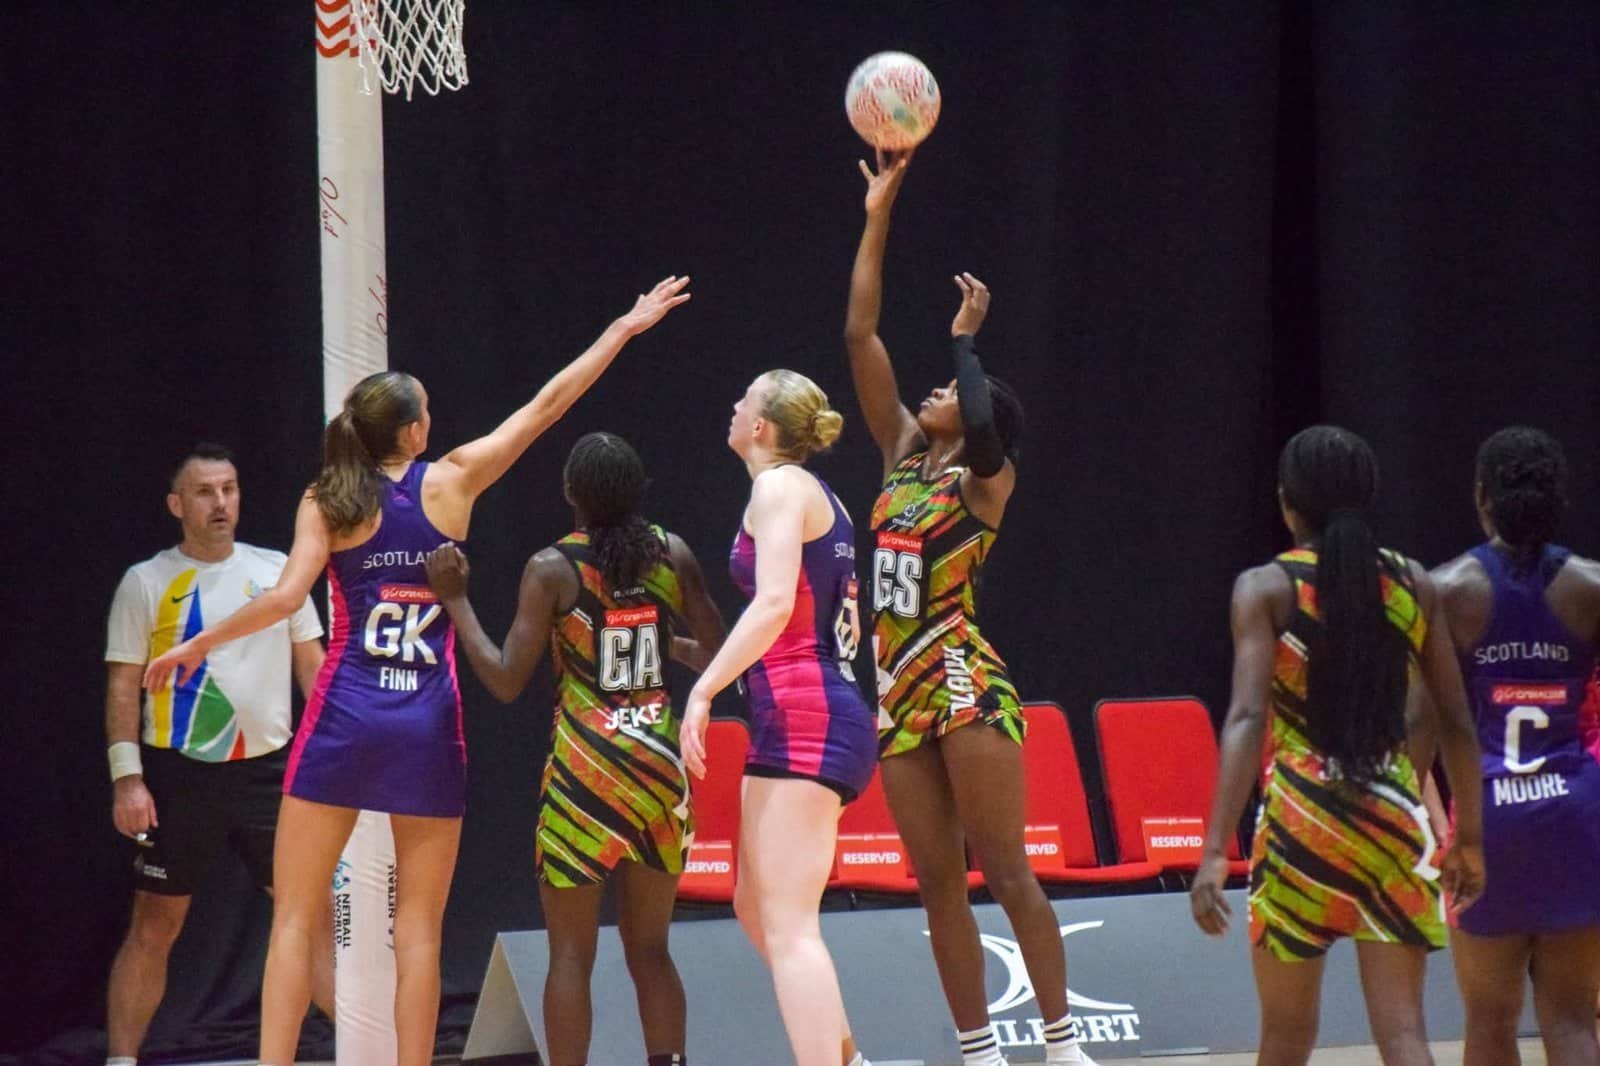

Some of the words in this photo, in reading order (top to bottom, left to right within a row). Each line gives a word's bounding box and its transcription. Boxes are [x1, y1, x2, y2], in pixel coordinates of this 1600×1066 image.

[363, 551, 431, 569] SCOTLA
[873, 548, 923, 618] GS
[365, 602, 442, 664] GK
[600, 623, 663, 691] GA
[1475, 642, 1569, 665] SCOTLAND
[380, 667, 418, 691] FINN
[604, 703, 663, 730] JEKE
[1504, 706, 1550, 773] C
[1493, 773, 1569, 806] MOORE
[1024, 844, 1059, 856] ERVED
[1150, 836, 1203, 848] RESERVED
[685, 862, 730, 873] SERVED
[843, 852, 901, 864] RESERVED
[342, 894, 351, 948] NETBALL
[989, 1013, 1140, 1046] ILERT
